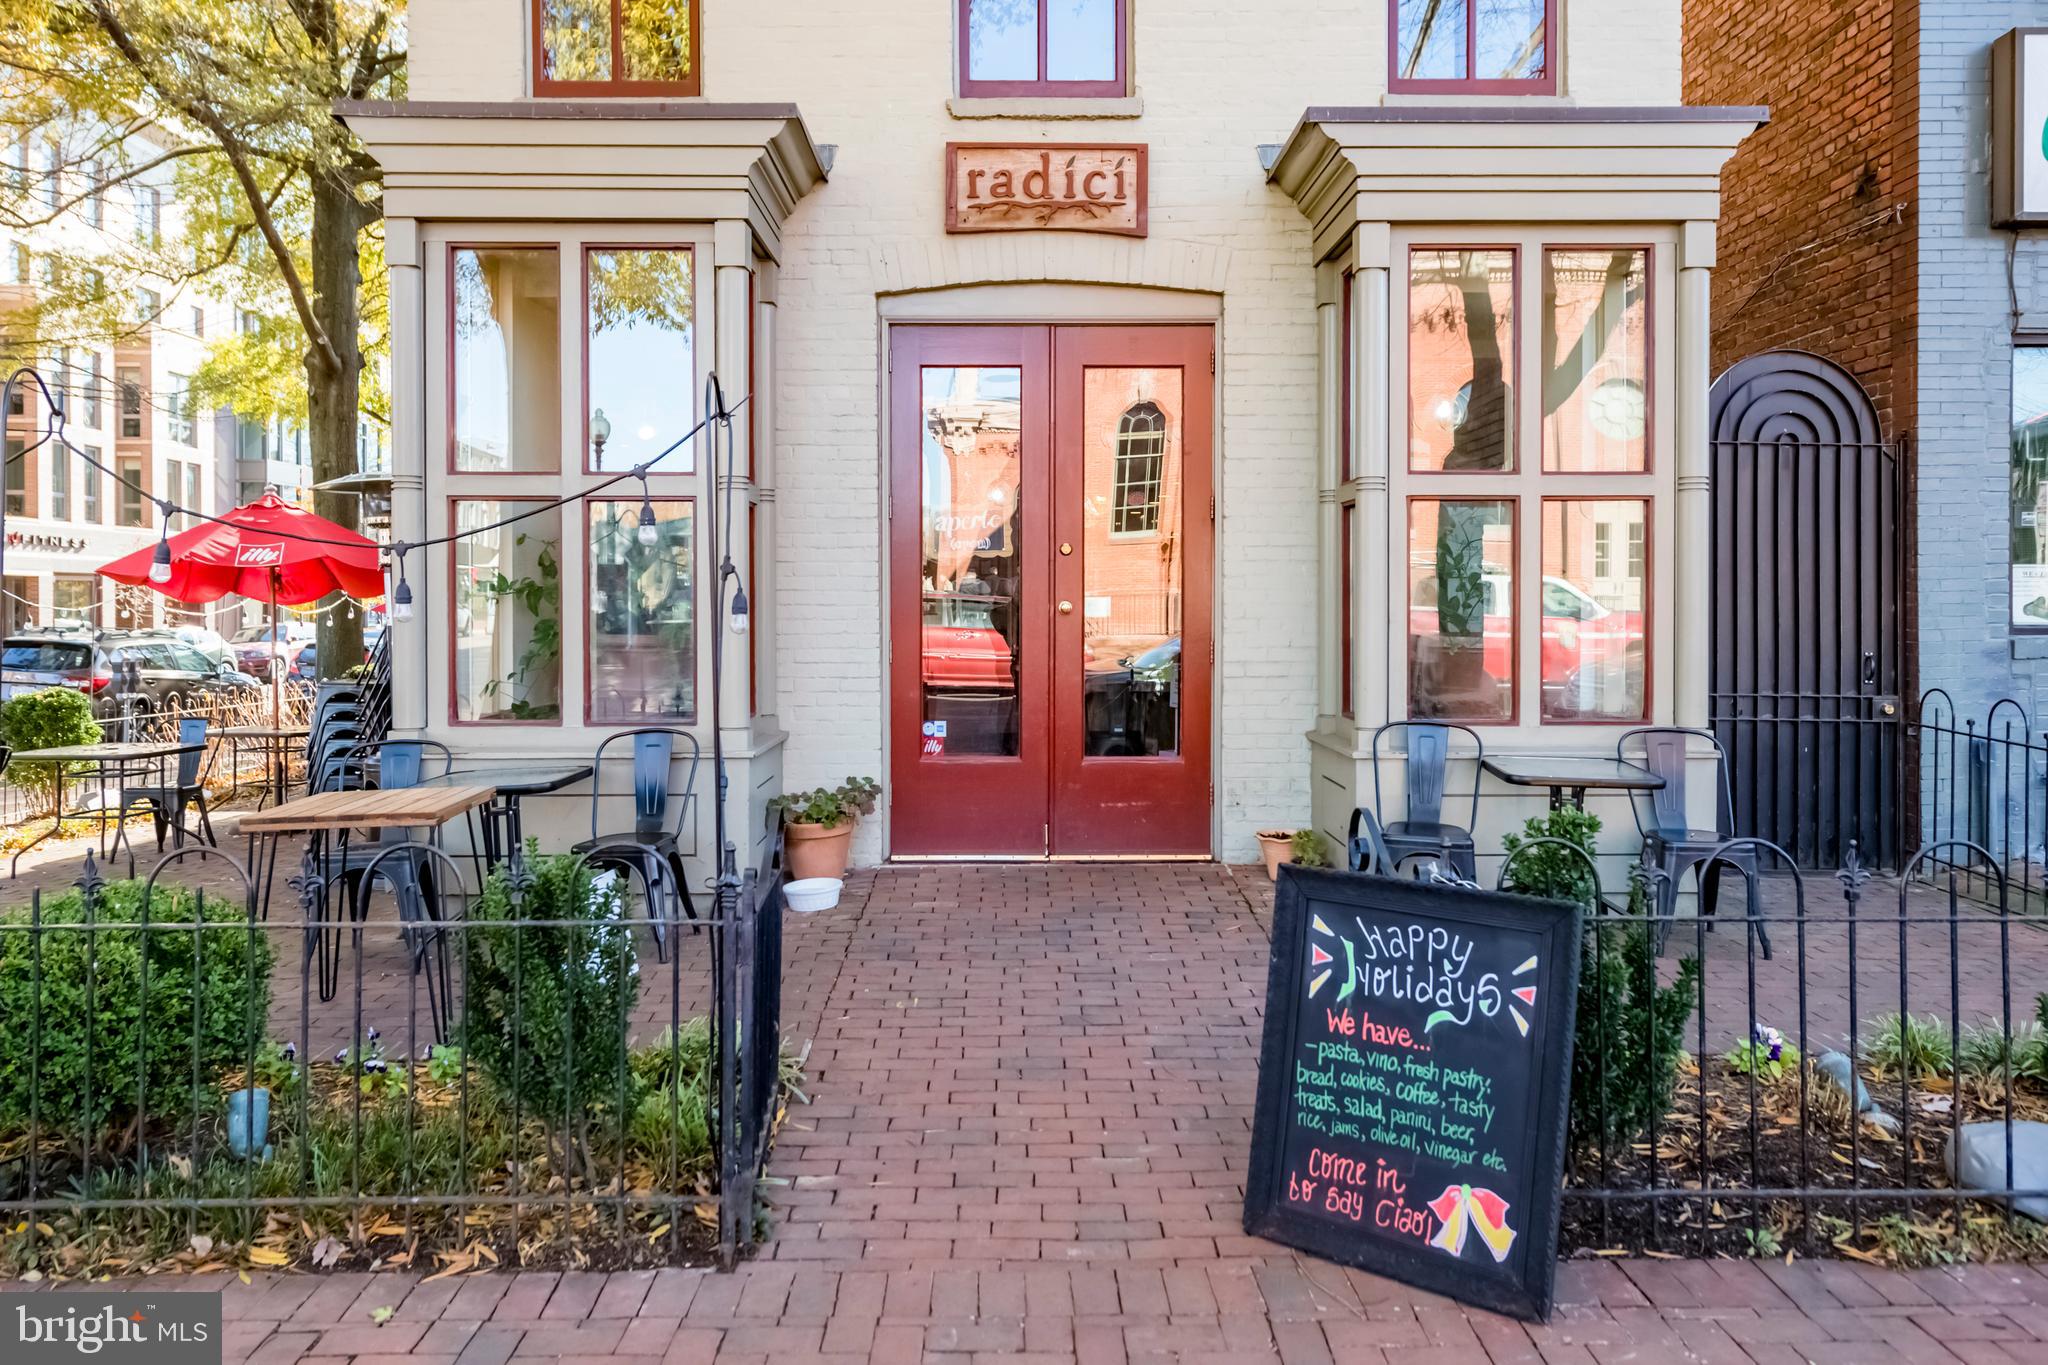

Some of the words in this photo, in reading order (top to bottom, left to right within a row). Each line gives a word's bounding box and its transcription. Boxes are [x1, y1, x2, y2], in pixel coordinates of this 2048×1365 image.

[240, 547, 280, 565] illy
[924, 739, 943, 756] illy
[1327, 1008, 1356, 1036] We
[1362, 1011, 1431, 1052] have...
[1366, 1051, 1401, 1075] vino,
[1403, 1054, 1439, 1082] fresh
[1297, 1059, 1337, 1089] bread,
[1340, 1068, 1391, 1096] cookies,
[1448, 1090, 1495, 1134] tasty
[1294, 1085, 1341, 1115] treats,
[1344, 1095, 1386, 1124] salad,
[1391, 1108, 1436, 1136] panini,
[1441, 1114, 1476, 1146] beer,
[1329, 1119, 1366, 1142] jams,
[1424, 1139, 1478, 1169] vinegar
[1482, 1147, 1507, 1172] etc.
[1289, 1171, 1317, 1202] to
